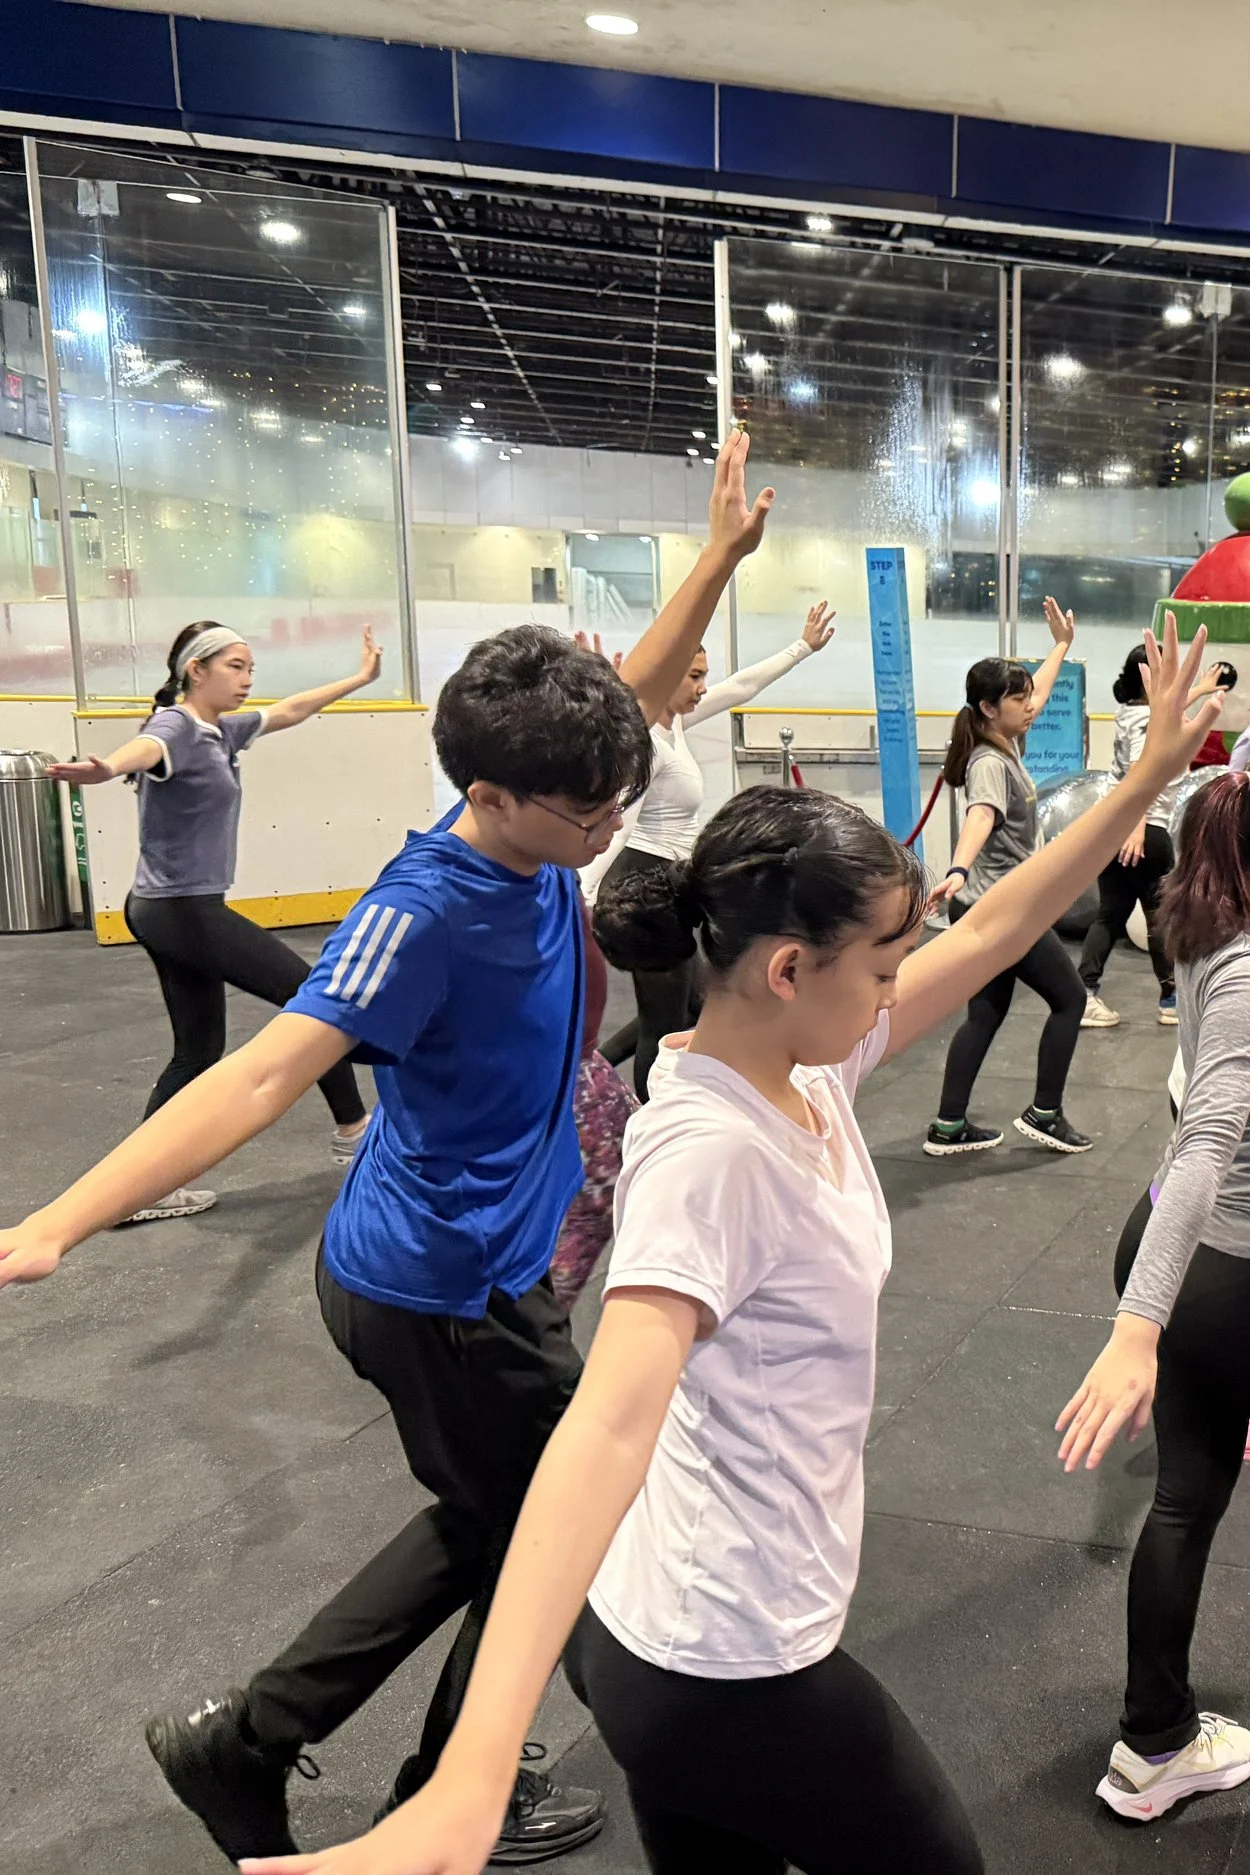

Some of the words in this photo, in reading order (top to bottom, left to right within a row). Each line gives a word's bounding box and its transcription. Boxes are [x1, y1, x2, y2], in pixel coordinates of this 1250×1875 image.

[870, 560, 893, 571] STEP
[1051, 694, 1069, 702] this
[1044, 749, 1057, 759] for
